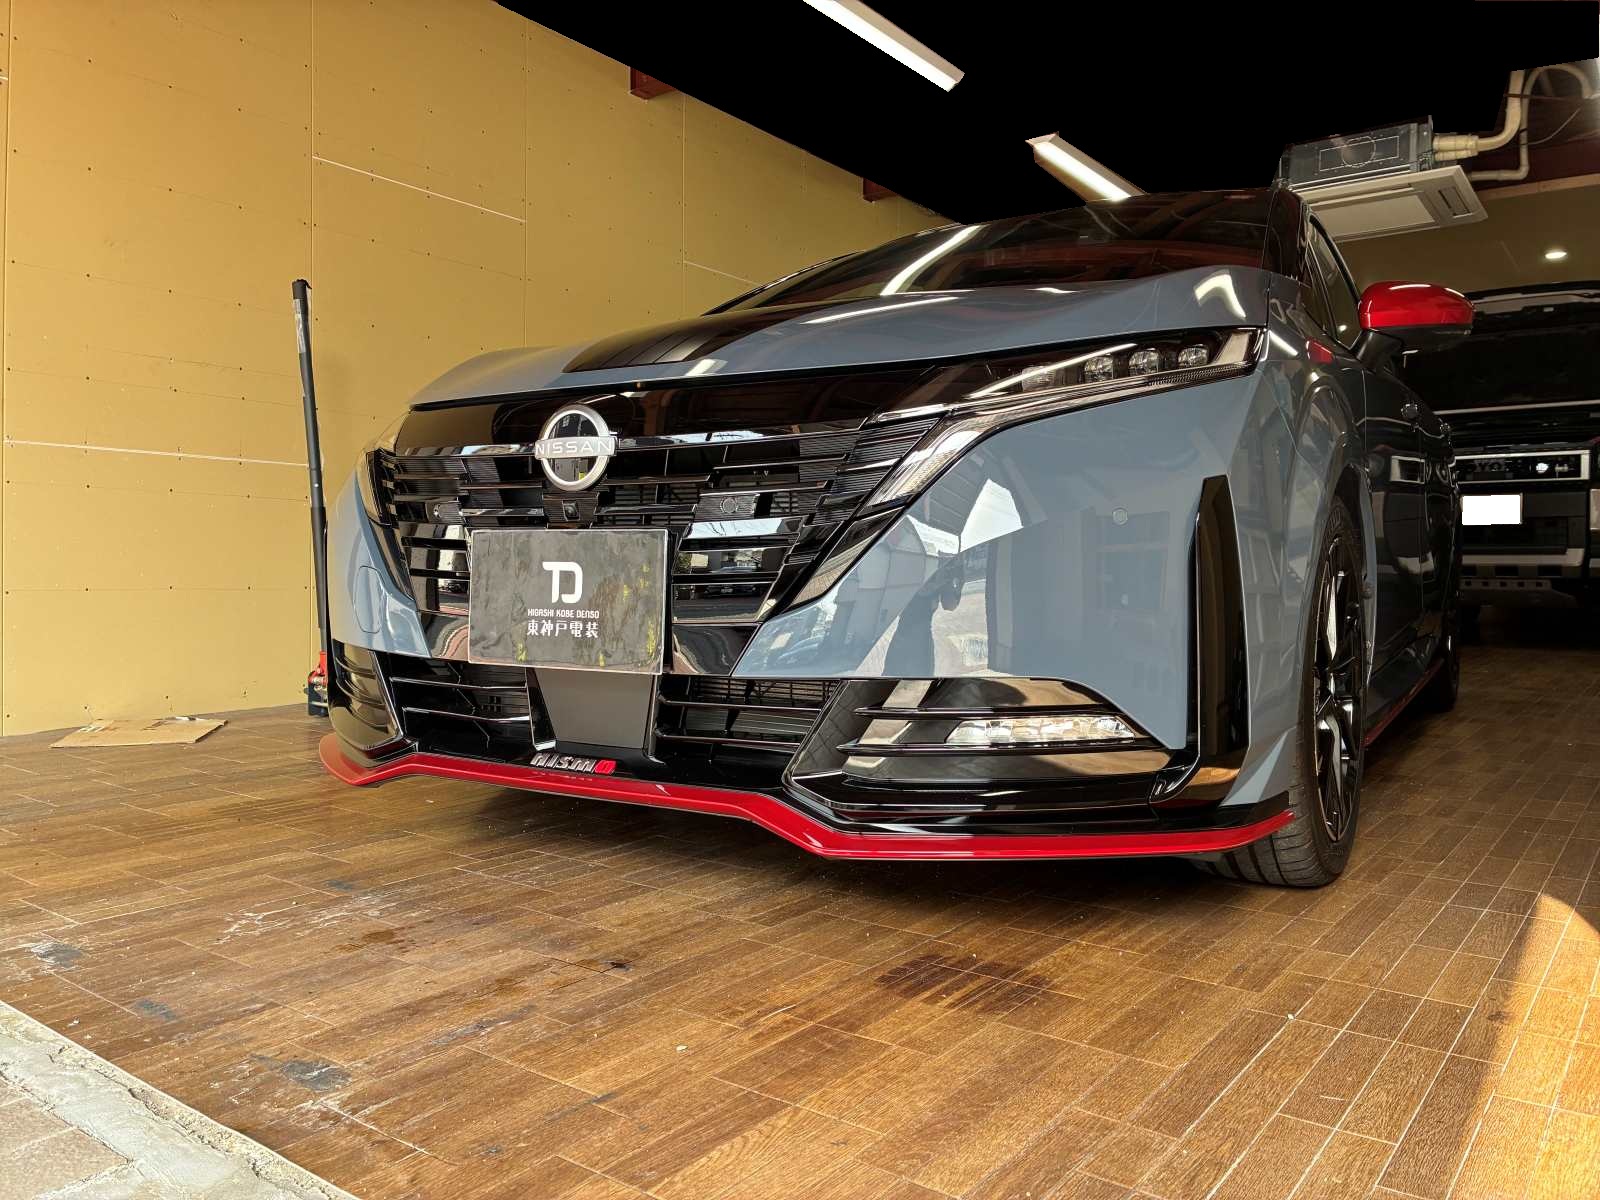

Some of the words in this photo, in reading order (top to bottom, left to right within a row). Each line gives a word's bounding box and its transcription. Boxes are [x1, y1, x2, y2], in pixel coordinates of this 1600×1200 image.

[535, 438, 612, 456] NISSAN
[527, 608, 554, 617] HIGASHI
[556, 609, 575, 618] KOBE
[576, 610, 600, 619] DENSO
[526, 619, 599, 638] 東神戸電装
